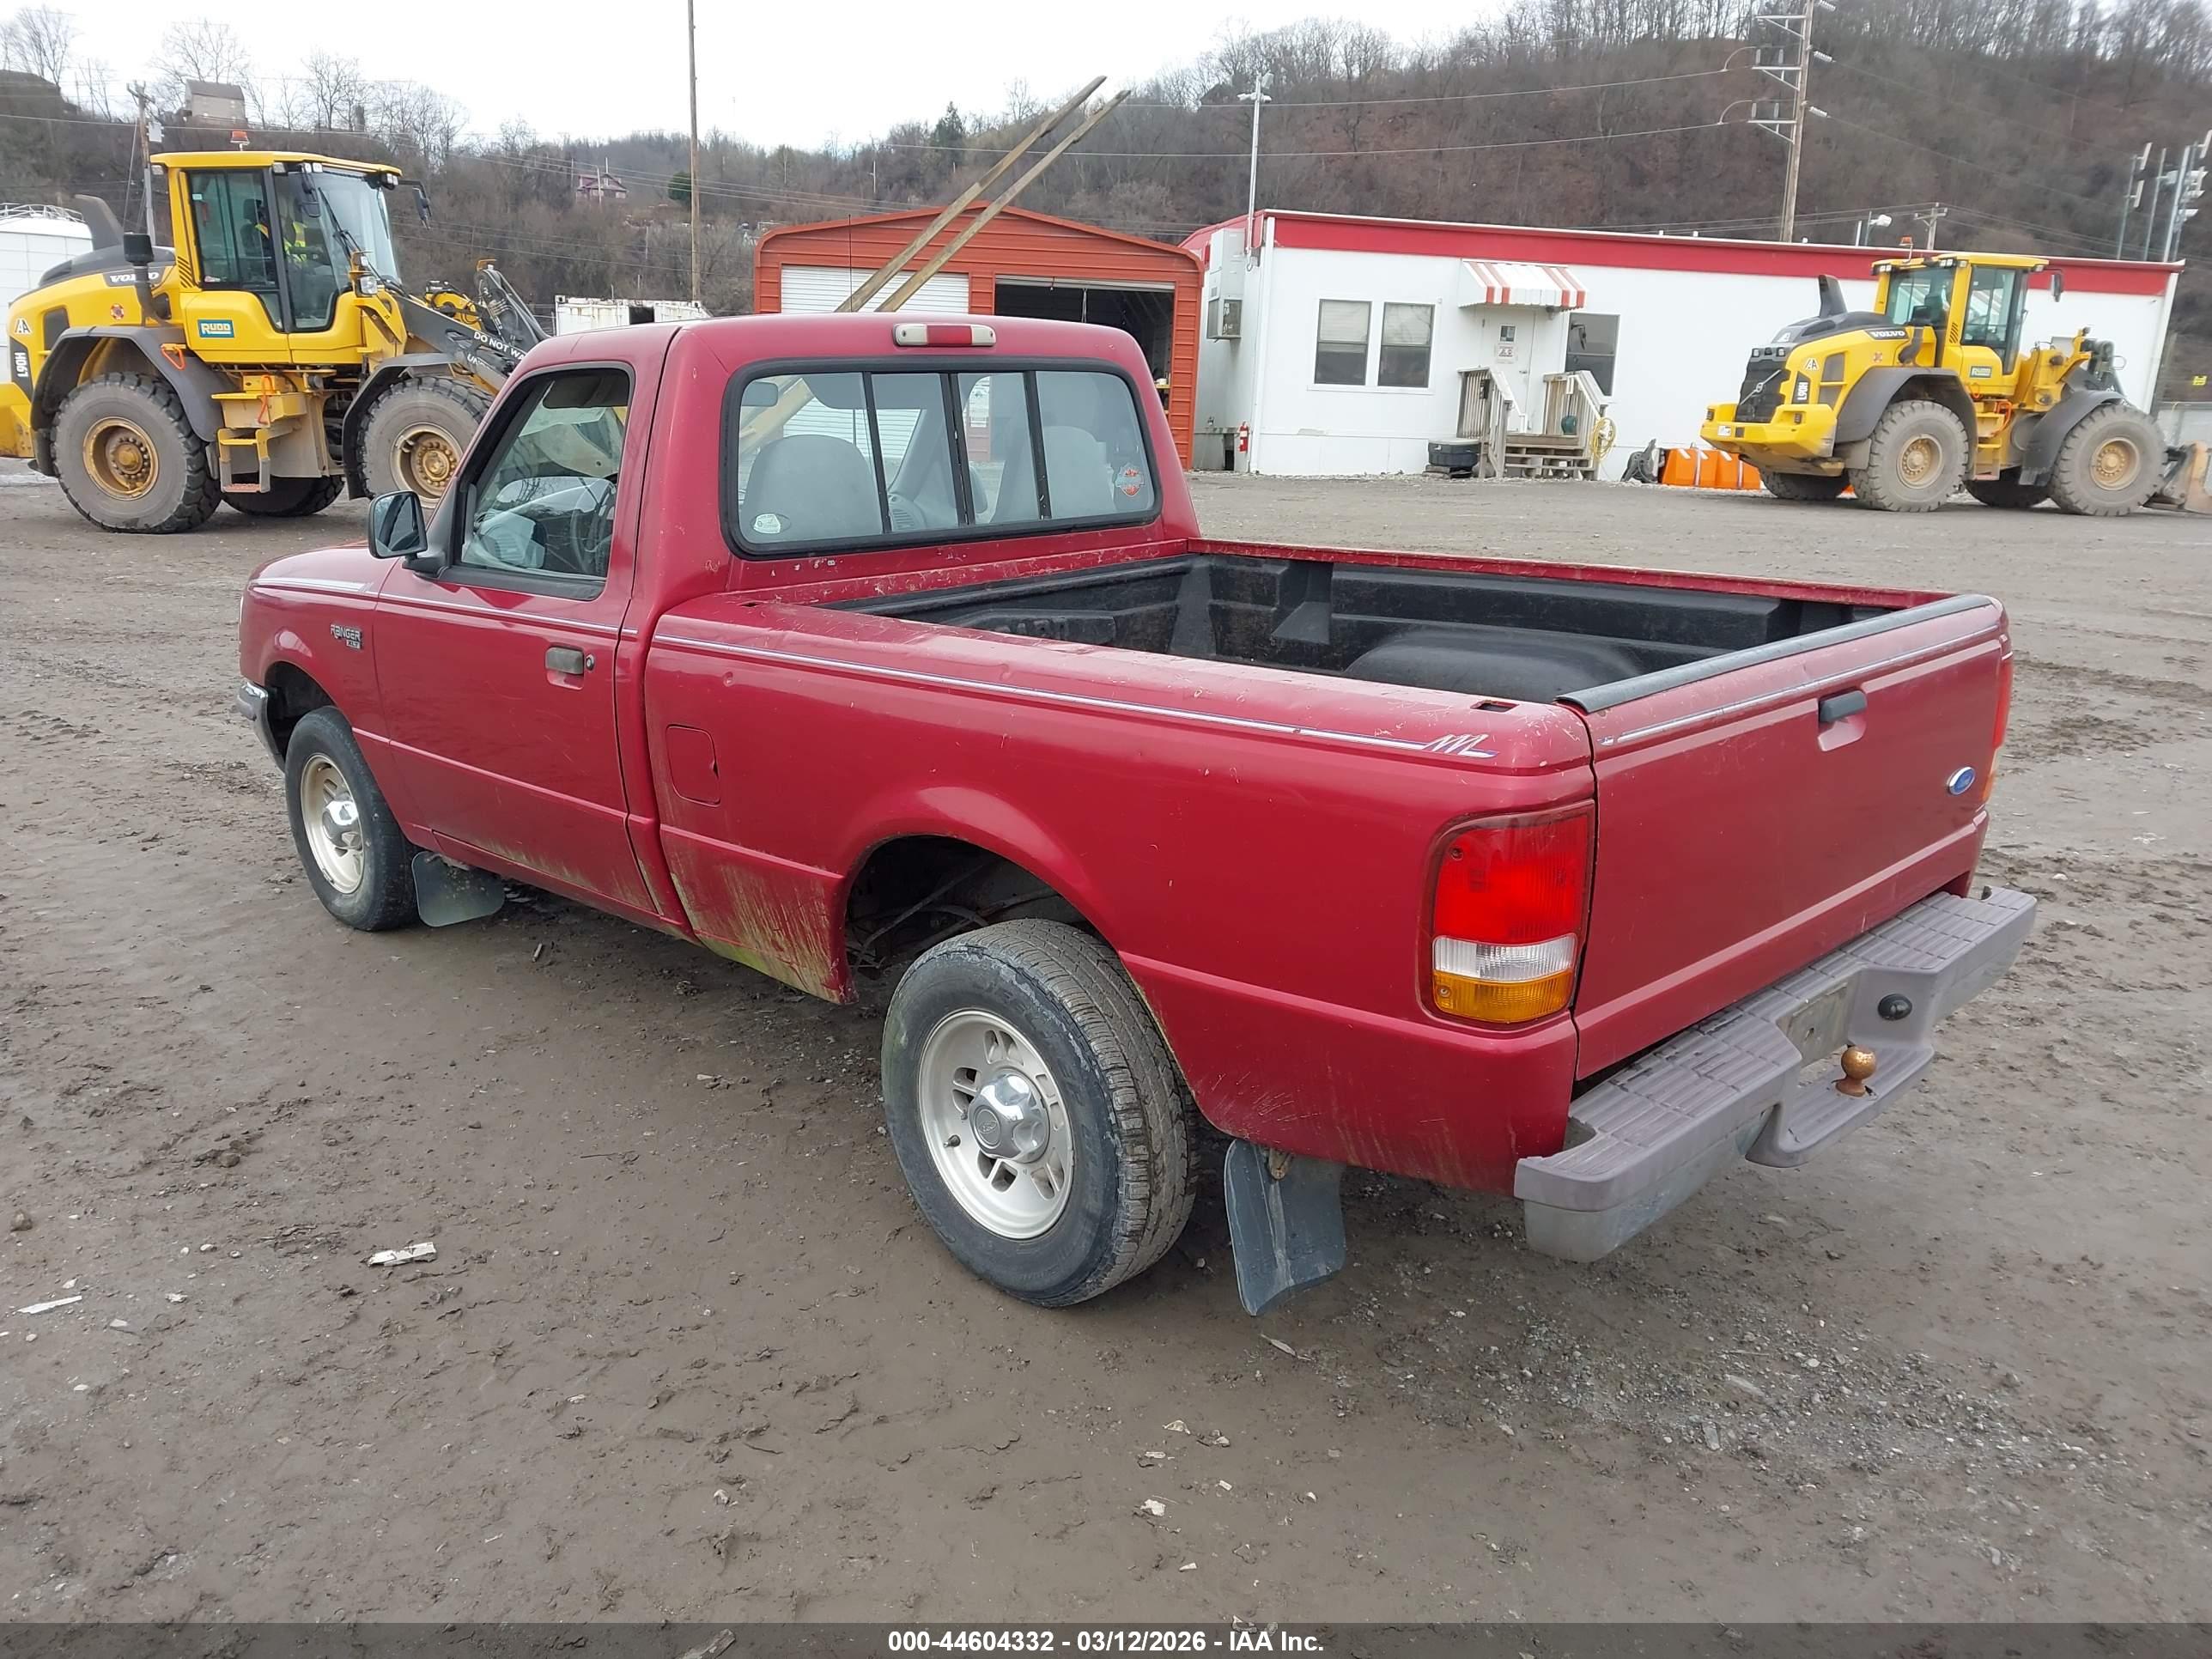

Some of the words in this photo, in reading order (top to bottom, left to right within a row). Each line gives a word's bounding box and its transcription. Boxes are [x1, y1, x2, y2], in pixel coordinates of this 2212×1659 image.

[110, 271, 159, 283] VOLO
[200, 323, 231, 335] RUDD
[474, 331, 488, 343] DO
[489, 338, 509, 352] NOT
[15, 352, 28, 378] L90H
[1797, 382, 1808, 400] L90H
[330, 624, 361, 641] RANGER
[347, 640, 360, 648] XLT
